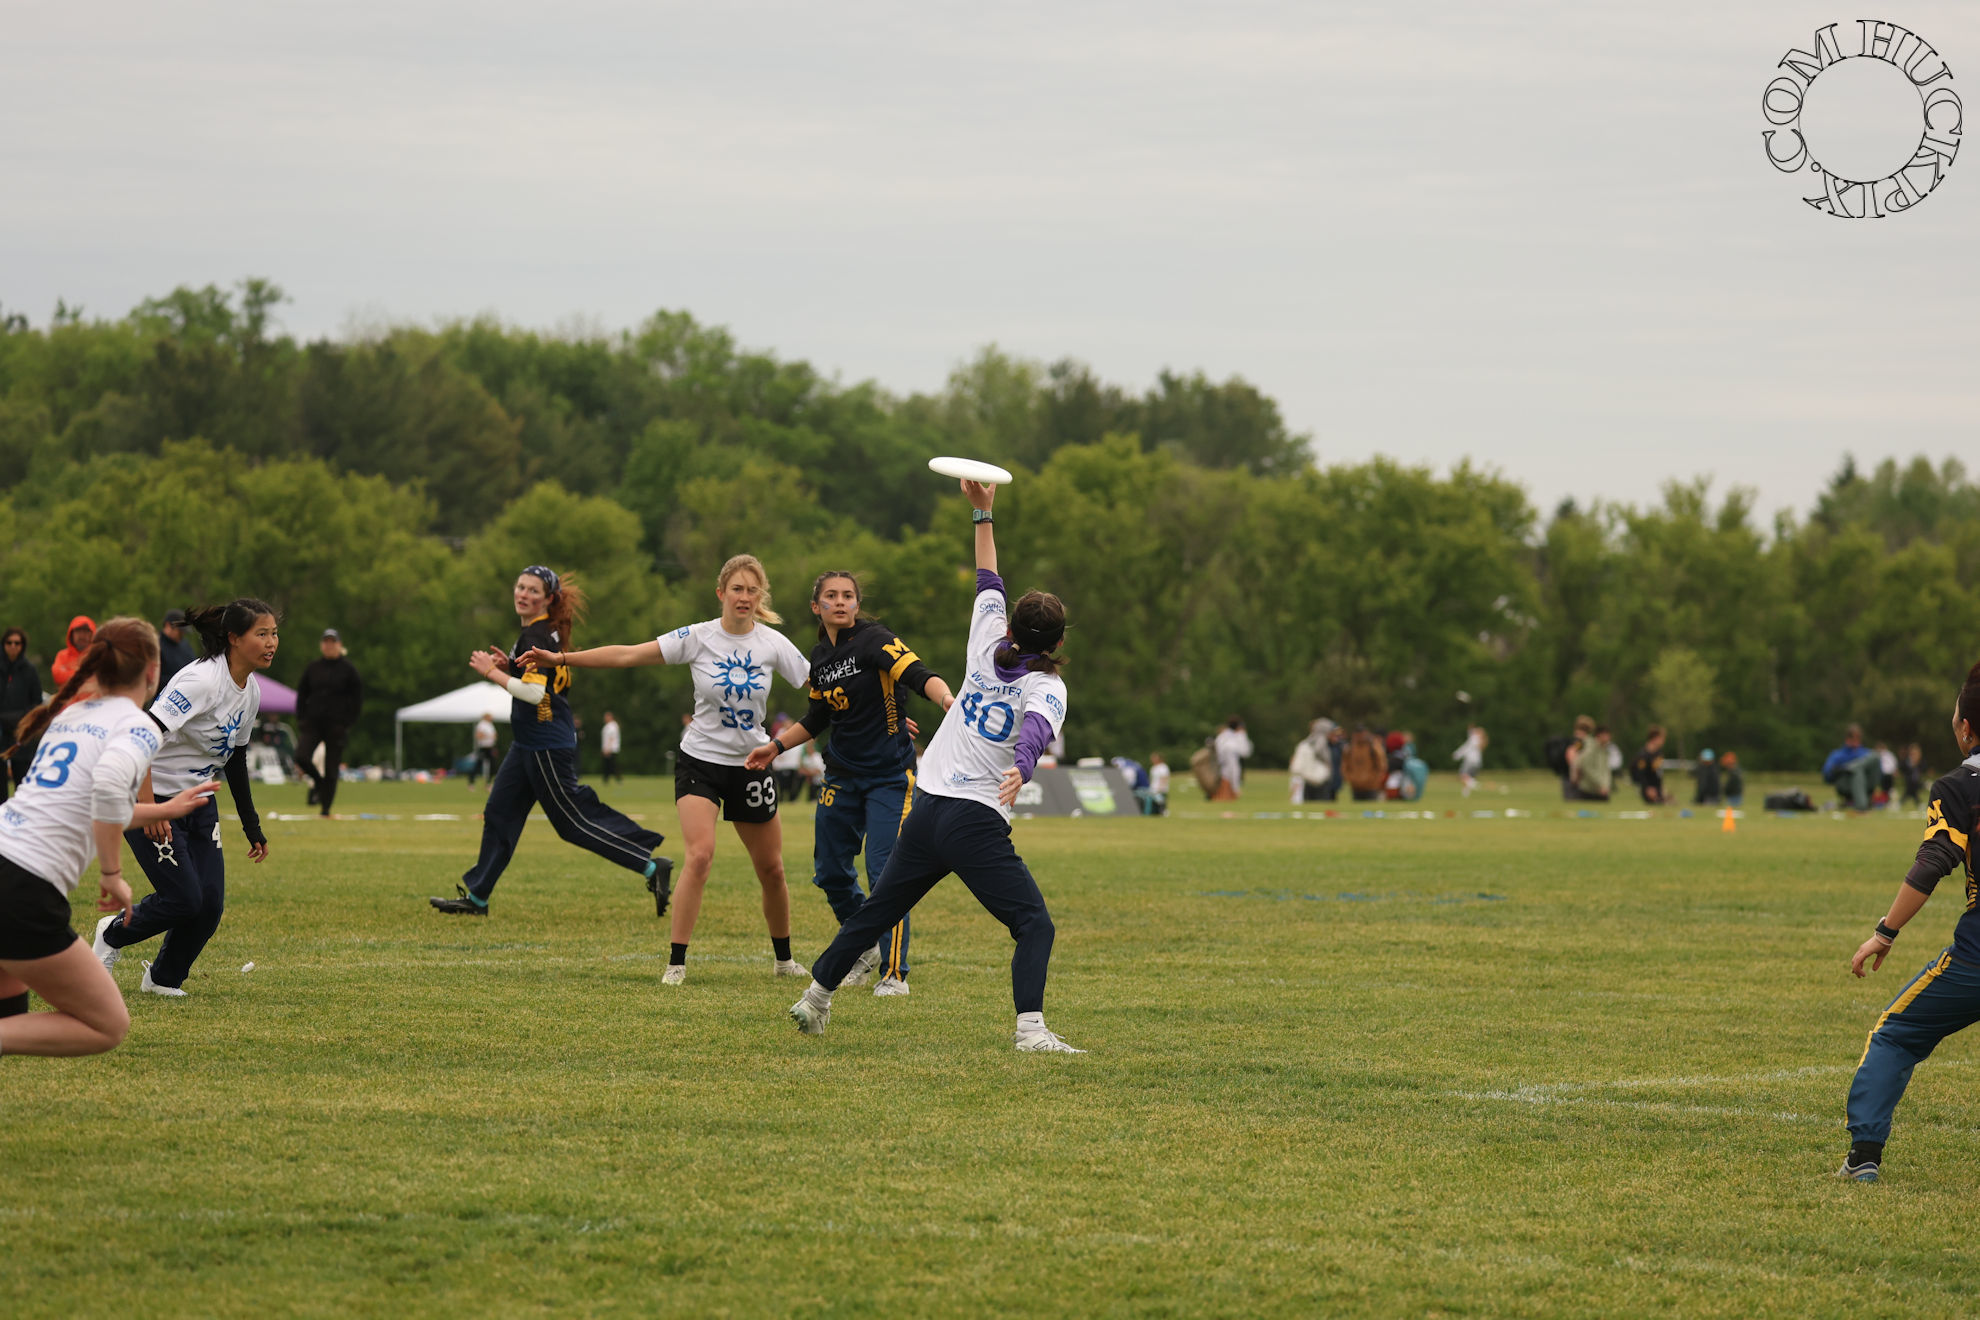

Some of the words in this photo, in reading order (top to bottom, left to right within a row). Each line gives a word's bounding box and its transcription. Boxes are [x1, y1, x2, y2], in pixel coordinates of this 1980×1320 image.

[882, 637, 910, 661] M
[168, 689, 192, 714] WWU
[823, 686, 849, 711] 36
[719, 707, 754, 731] 33
[960, 692, 1015, 742] 40
[26, 741, 78, 788] 13
[745, 776, 776, 807] 33
[818, 786, 836, 807] 36
